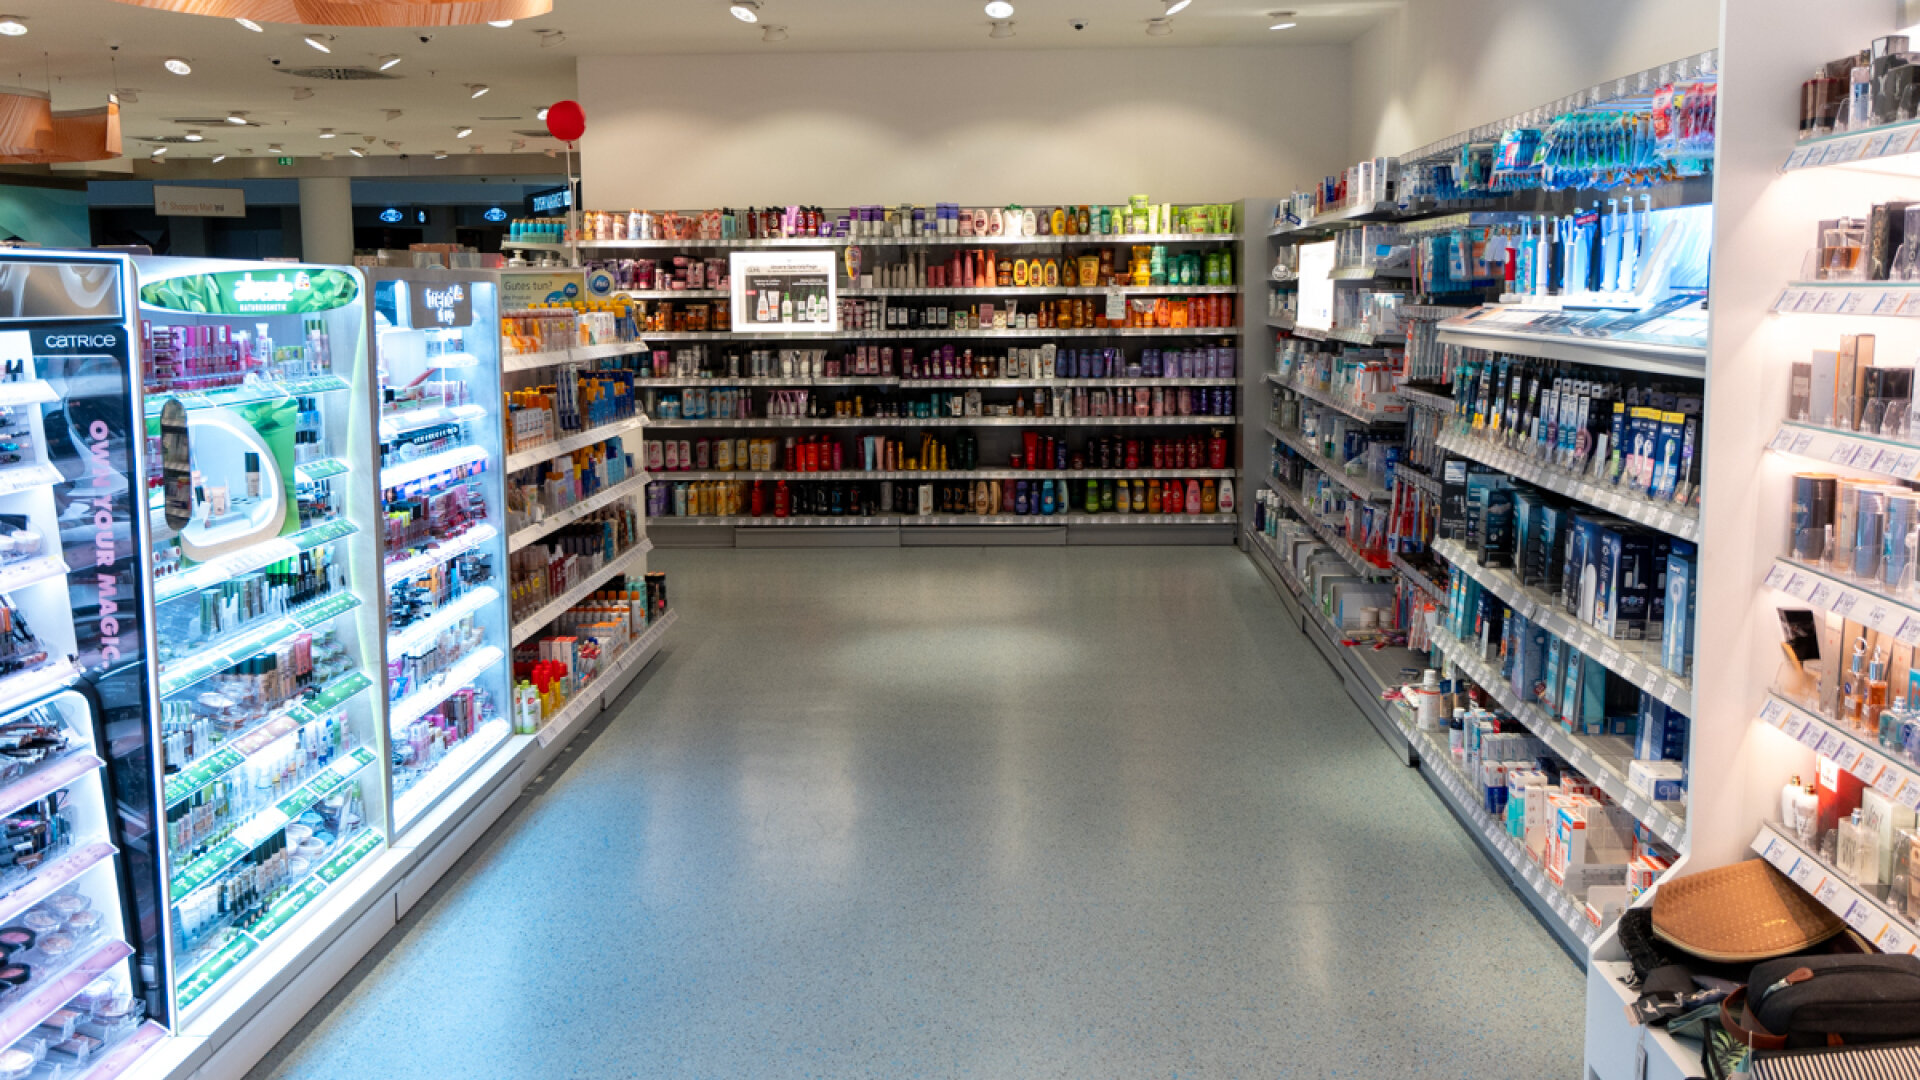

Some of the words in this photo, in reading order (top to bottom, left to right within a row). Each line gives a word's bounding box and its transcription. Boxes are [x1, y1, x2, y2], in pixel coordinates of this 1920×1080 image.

[169, 201, 199, 213] Shopping
[503, 281, 531, 291] Gutes
[534, 281, 553, 291] tun?
[89, 419, 111, 487] OWN
[93, 494, 116, 567] YOUR
[98, 572, 121, 670] MAGIC.
